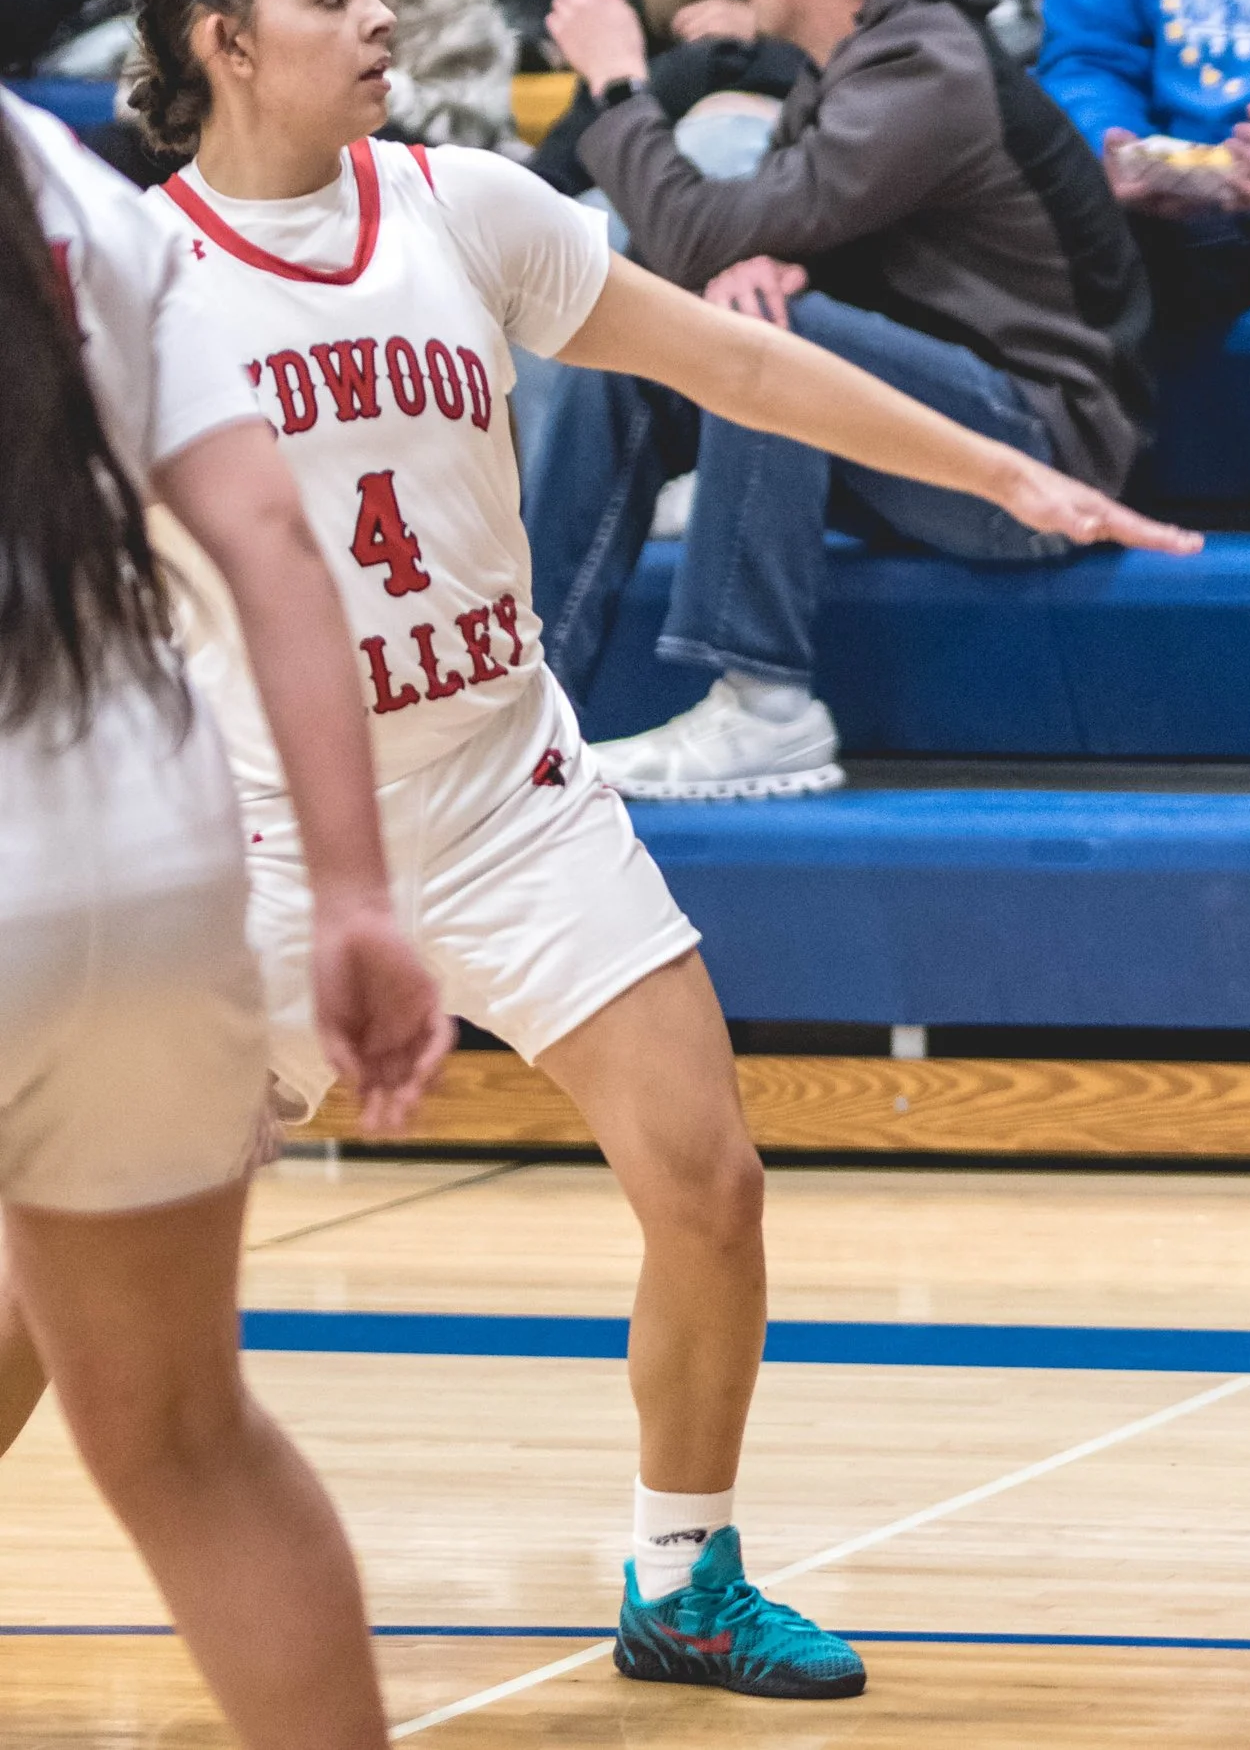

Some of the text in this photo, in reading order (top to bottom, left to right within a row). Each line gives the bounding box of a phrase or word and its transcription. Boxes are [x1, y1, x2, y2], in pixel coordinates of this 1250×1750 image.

[243, 336, 492, 439] DWOOD
[348, 469, 432, 598] 4
[359, 593, 523, 714] LLEY
